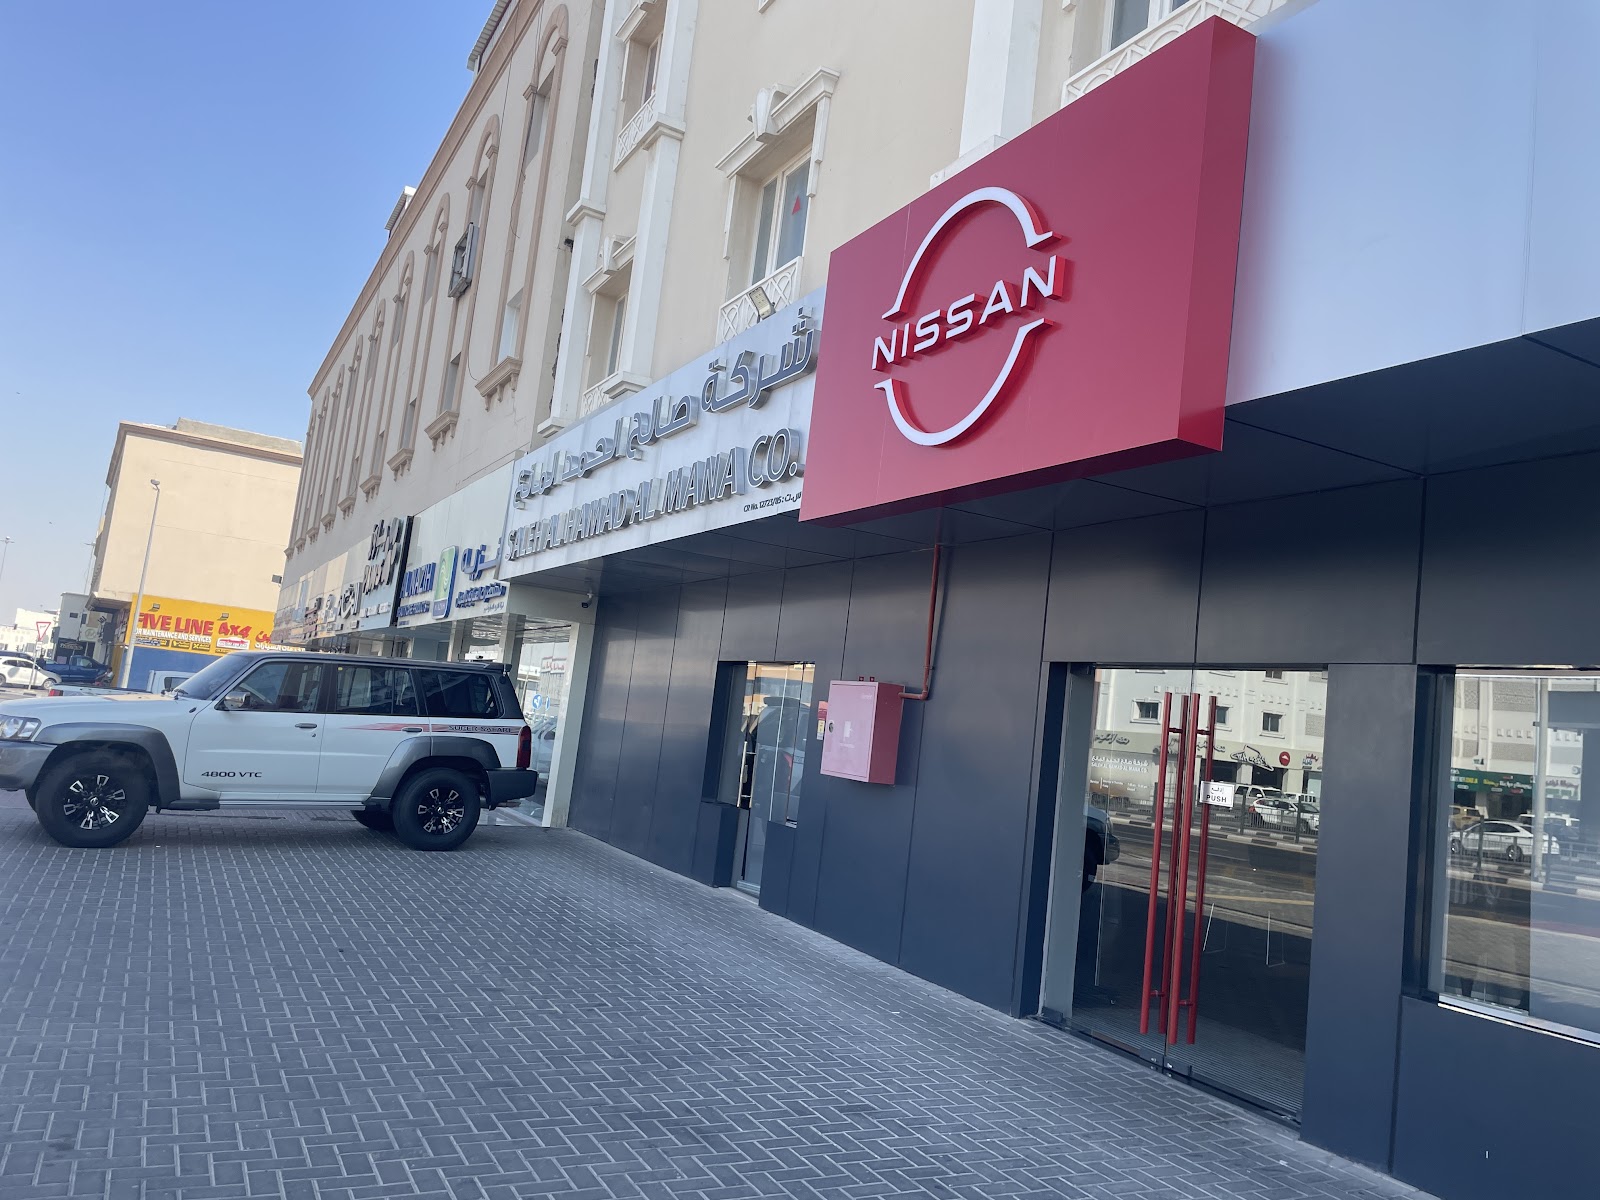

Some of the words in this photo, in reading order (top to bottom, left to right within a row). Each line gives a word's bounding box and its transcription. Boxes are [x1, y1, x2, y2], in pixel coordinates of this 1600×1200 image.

[872, 255, 1062, 370] NISSAN
[701, 305, 818, 411] شركة
[561, 416, 631, 481] الحمد
[627, 394, 696, 460] صالح
[504, 520, 544, 561] SALEH
[541, 513, 567, 549] AL
[562, 489, 634, 545] HAMAD
[629, 478, 662, 525] AL
[660, 447, 743, 515] MANA
[747, 427, 802, 488] CO.
[142, 629, 178, 639] MAINTENANCE
[178, 632, 189, 641] AND
[189, 634, 212, 643] SERVICES
[174, 617, 214, 636] LINE
[1205, 794, 1227, 803] PUSH
